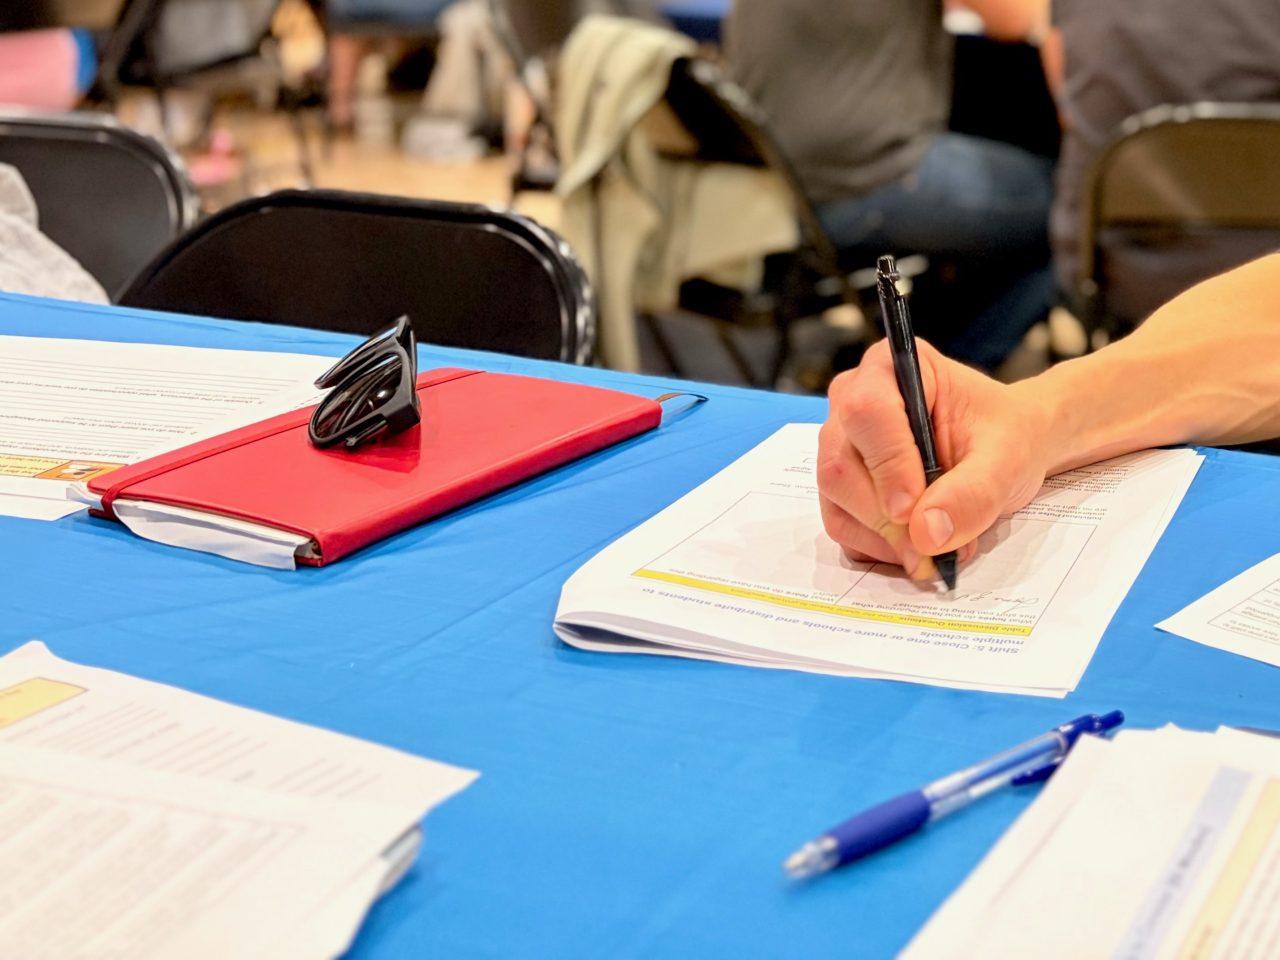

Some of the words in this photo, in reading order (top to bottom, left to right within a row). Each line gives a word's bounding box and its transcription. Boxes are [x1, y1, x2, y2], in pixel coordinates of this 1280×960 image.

[642, 587, 655, 595] to
[657, 591, 712, 607] students
[715, 603, 774, 622] distribute
[775, 616, 800, 627] and
[803, 620, 852, 634] schools
[854, 629, 888, 639] more
[919, 631, 969, 642] schools
[906, 636, 931, 645] one
[933, 641, 970, 650] Close
[972, 636, 1025, 646] multiple
[987, 645, 1020, 654] Shift
